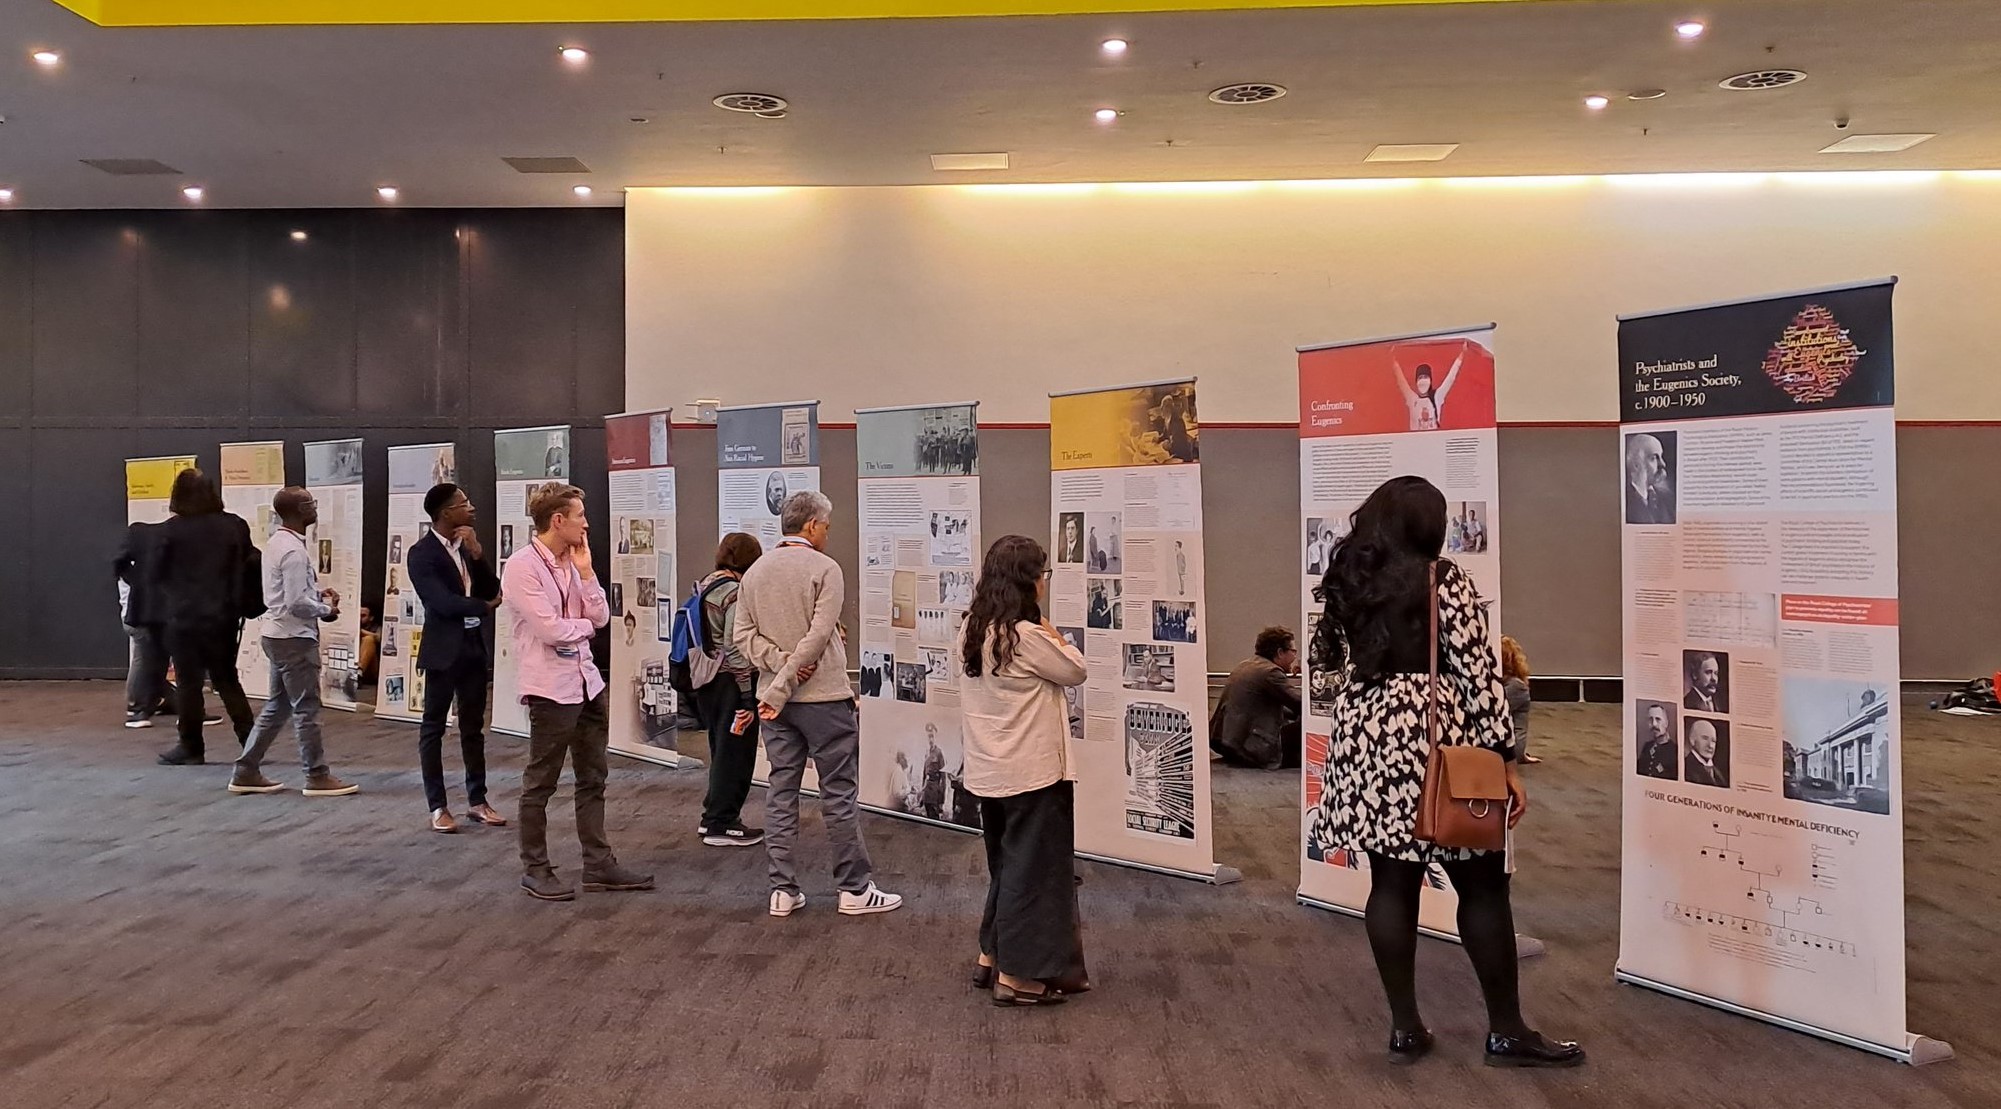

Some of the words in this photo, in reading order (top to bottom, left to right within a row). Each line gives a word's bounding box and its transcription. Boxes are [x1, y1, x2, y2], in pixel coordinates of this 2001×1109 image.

[1635, 358, 1696, 376] Psychiatrists
[1698, 354, 1718, 369] and
[1635, 379, 1650, 392] the
[1653, 375, 1699, 393] Eugenics
[1701, 372, 1742, 387] Society,
[1311, 400, 1354, 412] Confronting
[1311, 415, 1343, 427] Eugenics
[1061, 451, 1072, 460] The
[865, 461, 876, 470] The
[1645, 790, 1665, 801] FOUR
[1667, 794, 1723, 812] GENERATIONS
[1723, 805, 1734, 815] OF
[1736, 808, 1771, 822] INSANITY
[1777, 816, 1809, 830] MENTAL
[1810, 821, 1860, 839] DEFICIENCY
